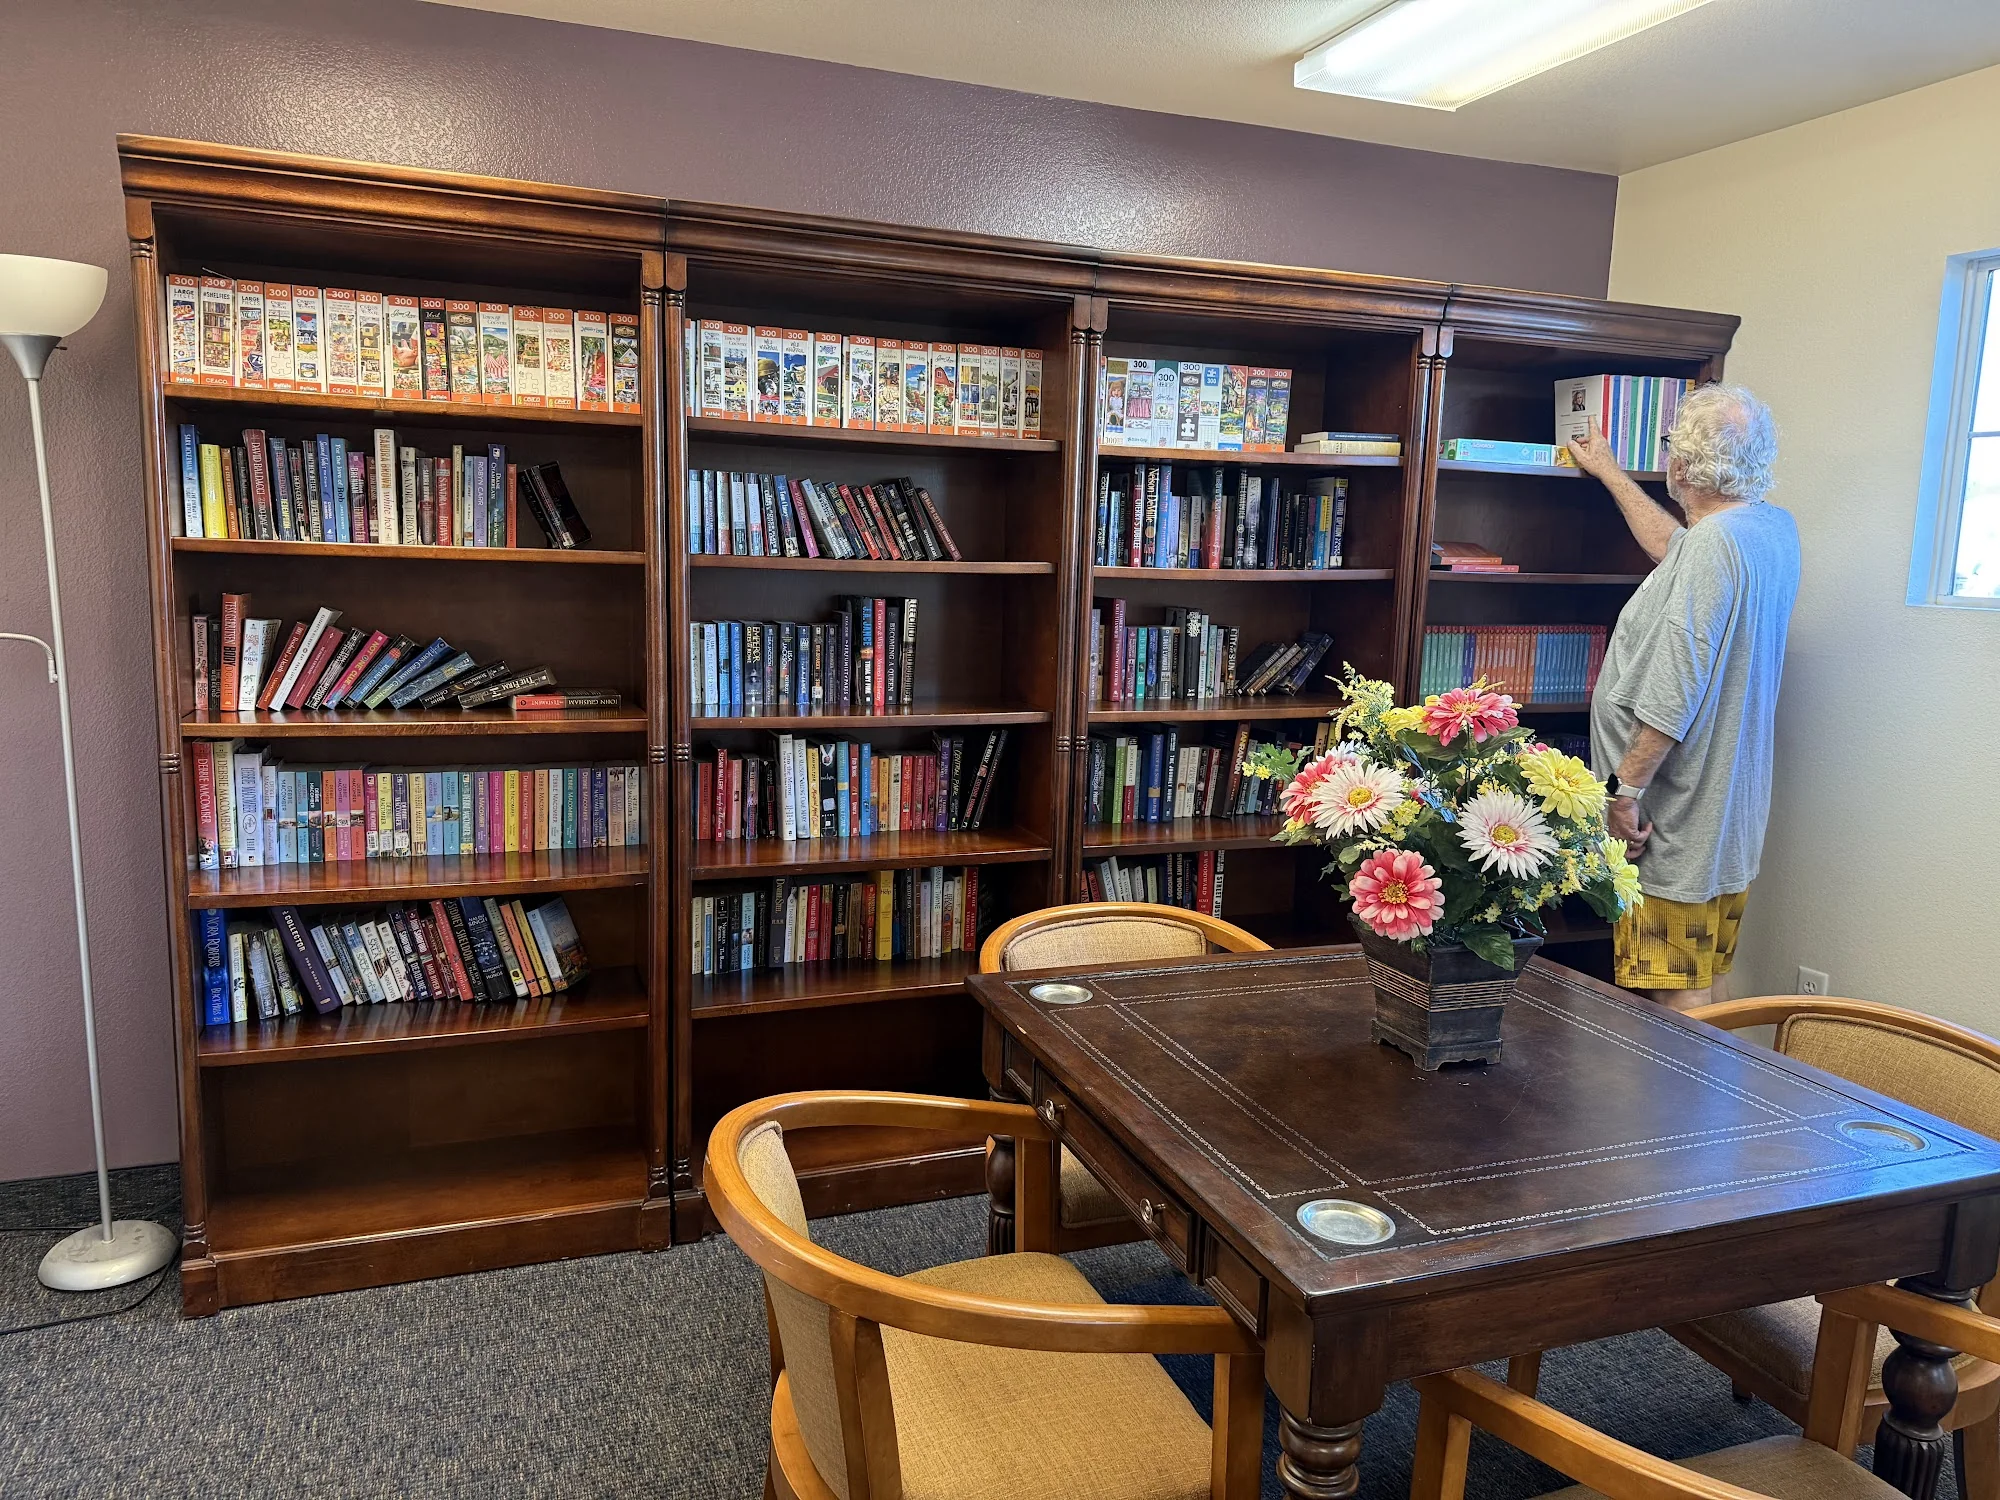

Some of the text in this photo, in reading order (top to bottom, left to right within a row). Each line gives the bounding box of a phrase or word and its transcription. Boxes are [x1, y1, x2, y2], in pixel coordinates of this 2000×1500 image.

[269, 289, 287, 297] 300
[424, 300, 441, 308] 300
[549, 312, 564, 320] 300
[617, 315, 632, 323] 300
[252, 443, 265, 495] DAVID BALDACCI
[350, 467, 359, 494] BRENNAN
[379, 435, 395, 530] SANDRA BROWN white hot
[404, 472, 415, 544] SANDRA BROWN
[438, 477, 448, 542] SANDRA BROWN
[1145, 468, 1159, 523] Nelson DeMille
[310, 500, 320, 537] OVERWATCH
[1335, 517, 1344, 537] OPTION
[196, 624, 204, 640] SHANA
[863, 607, 872, 645] J.A. JANCE
[223, 601, 236, 696] TESS GERRITSEN BODY DOUBLE
[752, 627, 761, 663] EMPEROR
[344, 640, 380, 686] NOT ONE CLUE
[397, 649, 434, 680] JOHN GRISHAM
[502, 676, 533, 689] THE FIRM
[953, 750, 962, 777] CENTRAL
[198, 759, 211, 824] DEBBIE MACOMBER
[217, 760, 231, 832] DEBBIE MACOMBER
[1103, 864, 1111, 886] SUSAN
[285, 915, 305, 952] COLLECTOR
[447, 902, 474, 962] SIDNEY SHELDON
[468, 918, 487, 927] SINGH
[367, 938, 380, 960] SALA
[386, 946, 399, 965] SALA
[414, 929, 428, 953] SANDFORD
[204, 917, 221, 1002] NORA ROBERTS BLACK
[356, 953, 368, 974] SALA
[399, 930, 427, 992] SANDFORD DEADLINE
